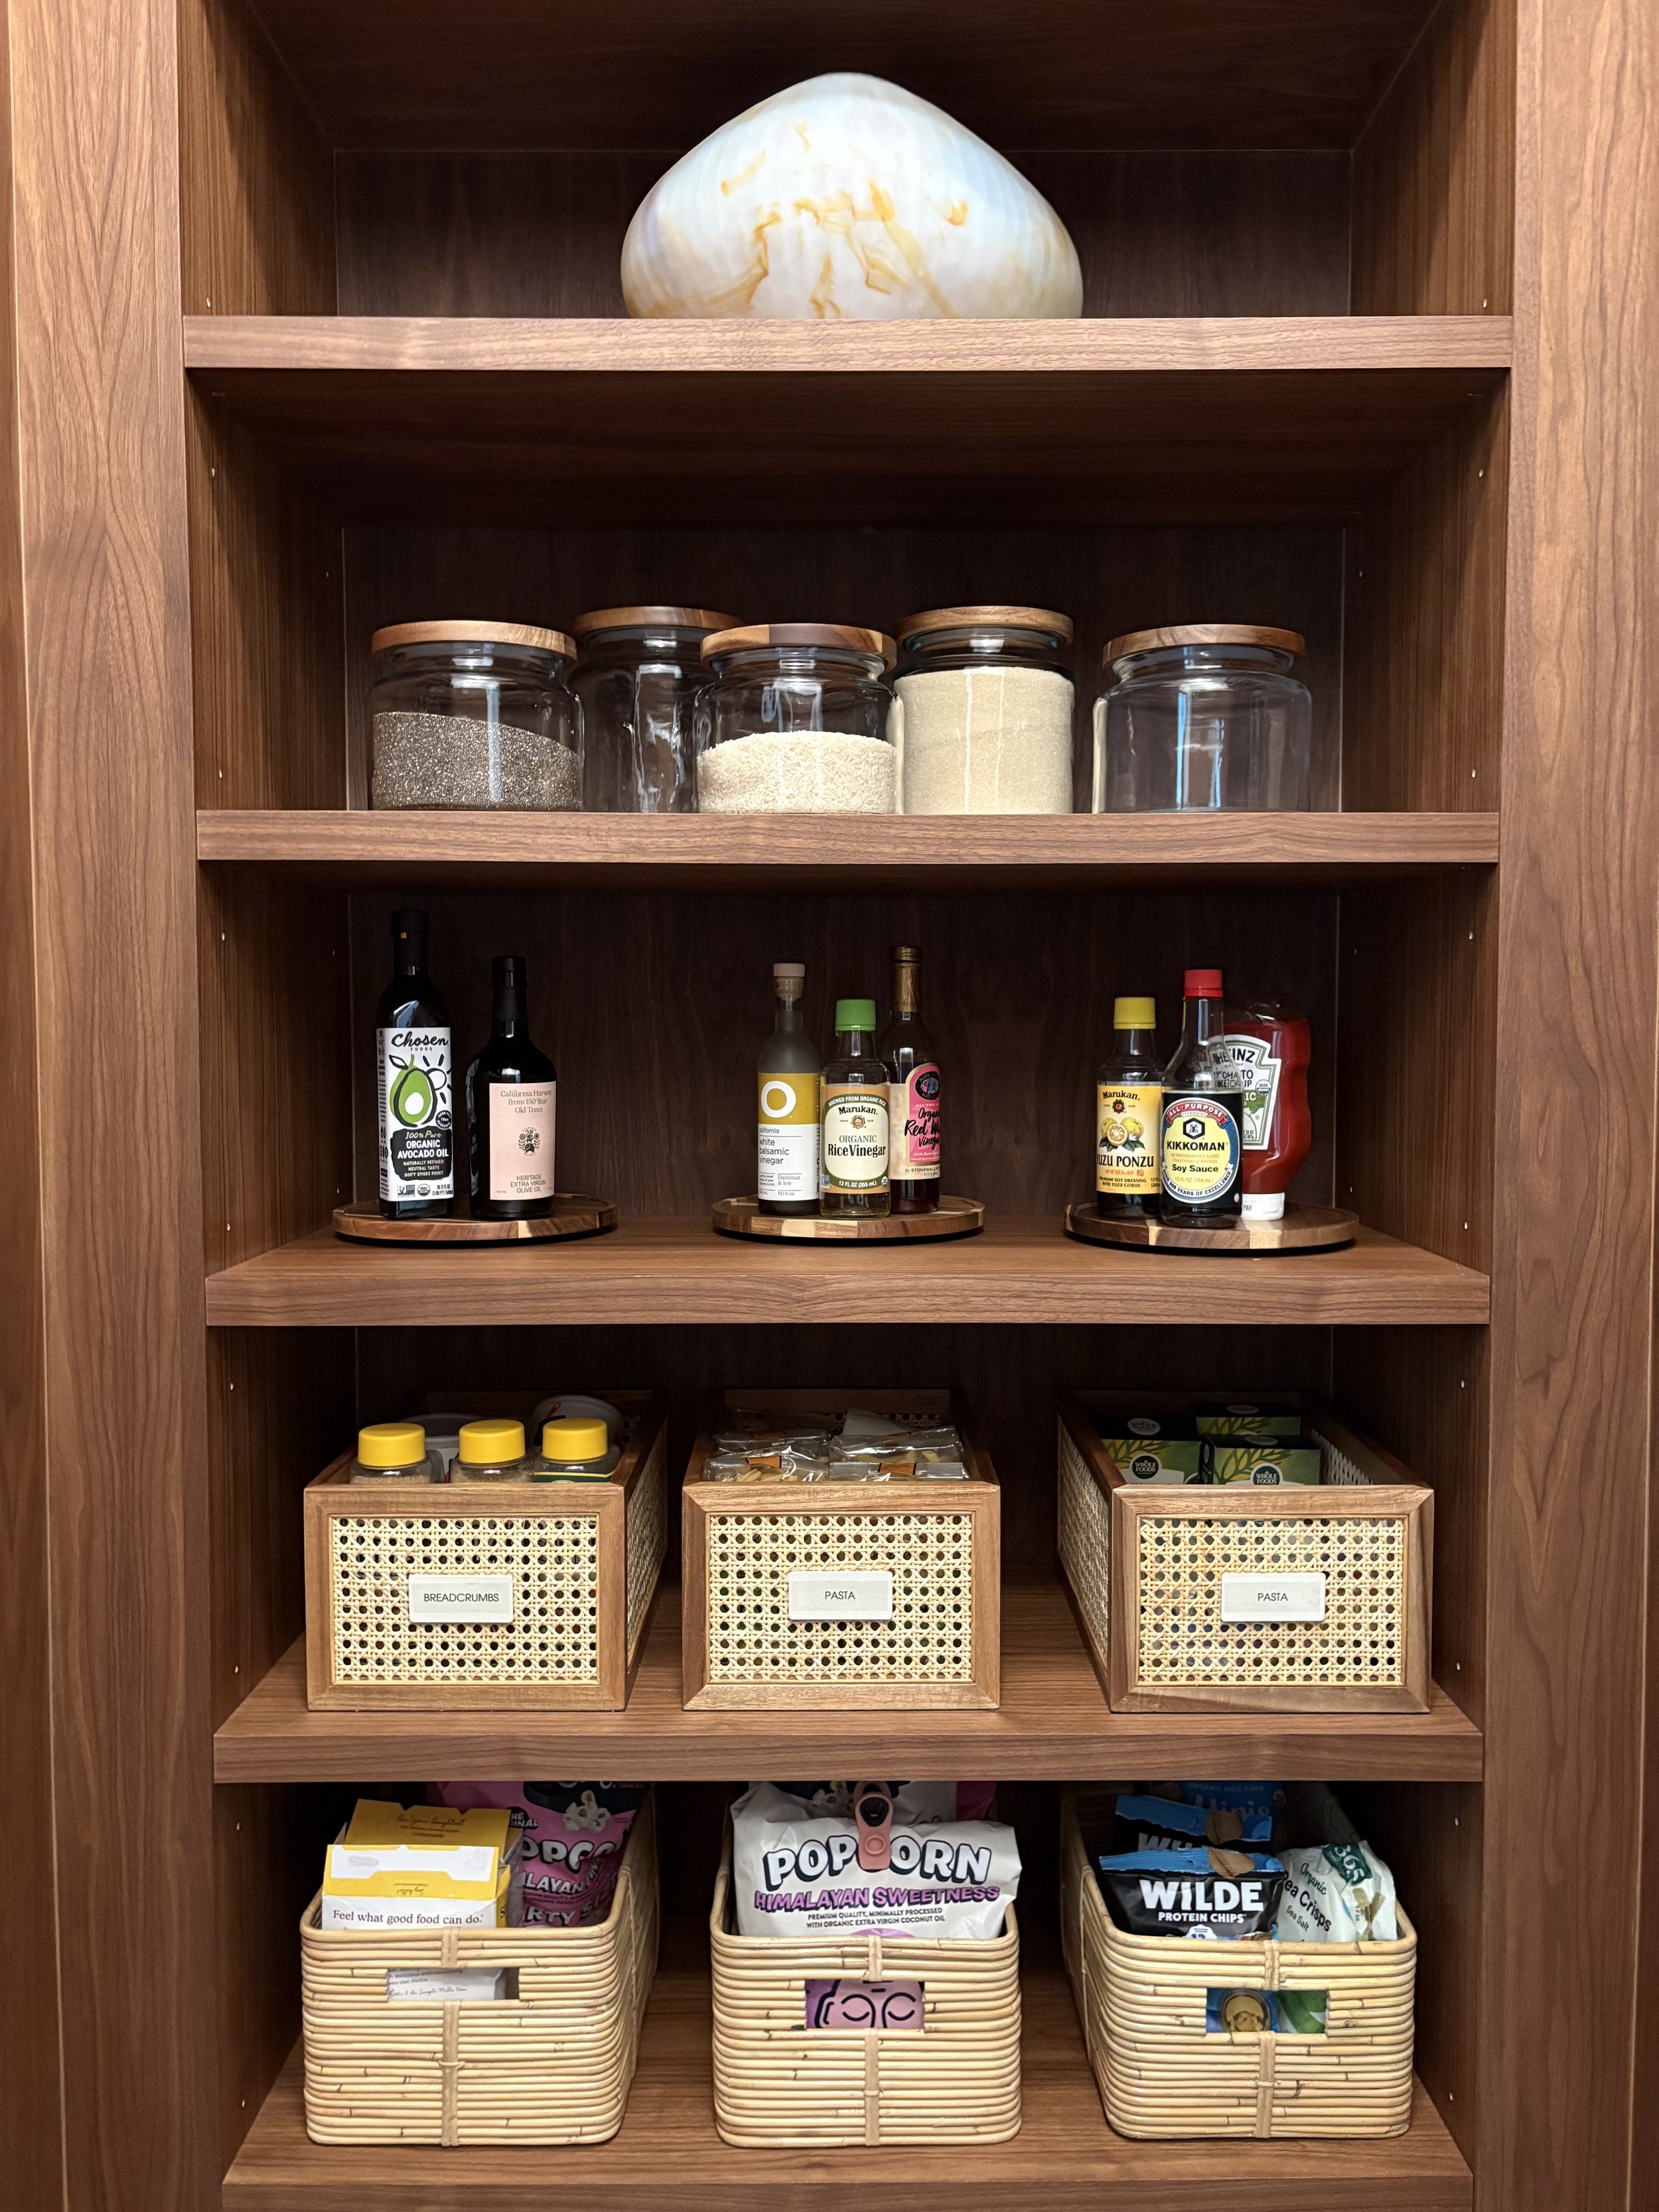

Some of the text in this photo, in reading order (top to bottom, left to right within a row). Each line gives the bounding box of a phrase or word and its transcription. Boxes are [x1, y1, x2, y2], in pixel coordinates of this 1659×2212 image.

[391, 1031, 449, 1047] Chosen
[1103, 1090, 1138, 1100] Marukan
[828, 1097, 845, 1107] BREWED
[838, 1105, 877, 1115] Marukan
[918, 1107, 940, 1123] Organ
[904, 1120, 928, 1136] Red
[406, 1140, 441, 1149] ORGANIC
[918, 1136, 940, 1150] Vinega
[1167, 1141, 1225, 1151] KIKKOMAN
[397, 1149, 435, 1159] AVOCADO
[759, 1147, 790, 1155] balsamic
[828, 1143, 887, 1158] Rice Vinegar
[760, 1155, 784, 1165] vinegar
[1116, 1156, 1154, 1167] PONZU
[1172, 1164, 1187, 1173] Soy
[1177, 1187, 1194, 1196] YEARS
[1204, 1171, 1231, 1195] EXCELLENCE
[424, 1593, 499, 1602] BREADCRUMBS
[824, 1591, 856, 1600] PASTA
[1257, 1593, 1289, 1601] PASTA
[510, 1812, 525, 1820] HE
[509, 1819, 540, 1828] INAL
[763, 1834, 992, 1891] POPORN
[1334, 1844, 1365, 1882] 365
[522, 1872, 584, 1894] LAYAN
[1301, 1863, 1327, 1895] Organic
[755, 1886, 1001, 1913] HIMALAYAN SWEETNESS
[1139, 1879, 1264, 1911] WILDE
[526, 1905, 576, 1925] RTY
[839, 1911, 868, 1919] QUALITY,
[1299, 1890, 1332, 1932] Crisps
[332, 1909, 354, 1921] Feel
[358, 1911, 384, 1923] what
[387, 1913, 413, 1925] good
[416, 1913, 439, 1924] food
[1158, 1912, 1245, 1923] PROTEIN CHIPS
[1286, 1905, 1309, 1931] Sea Salt
